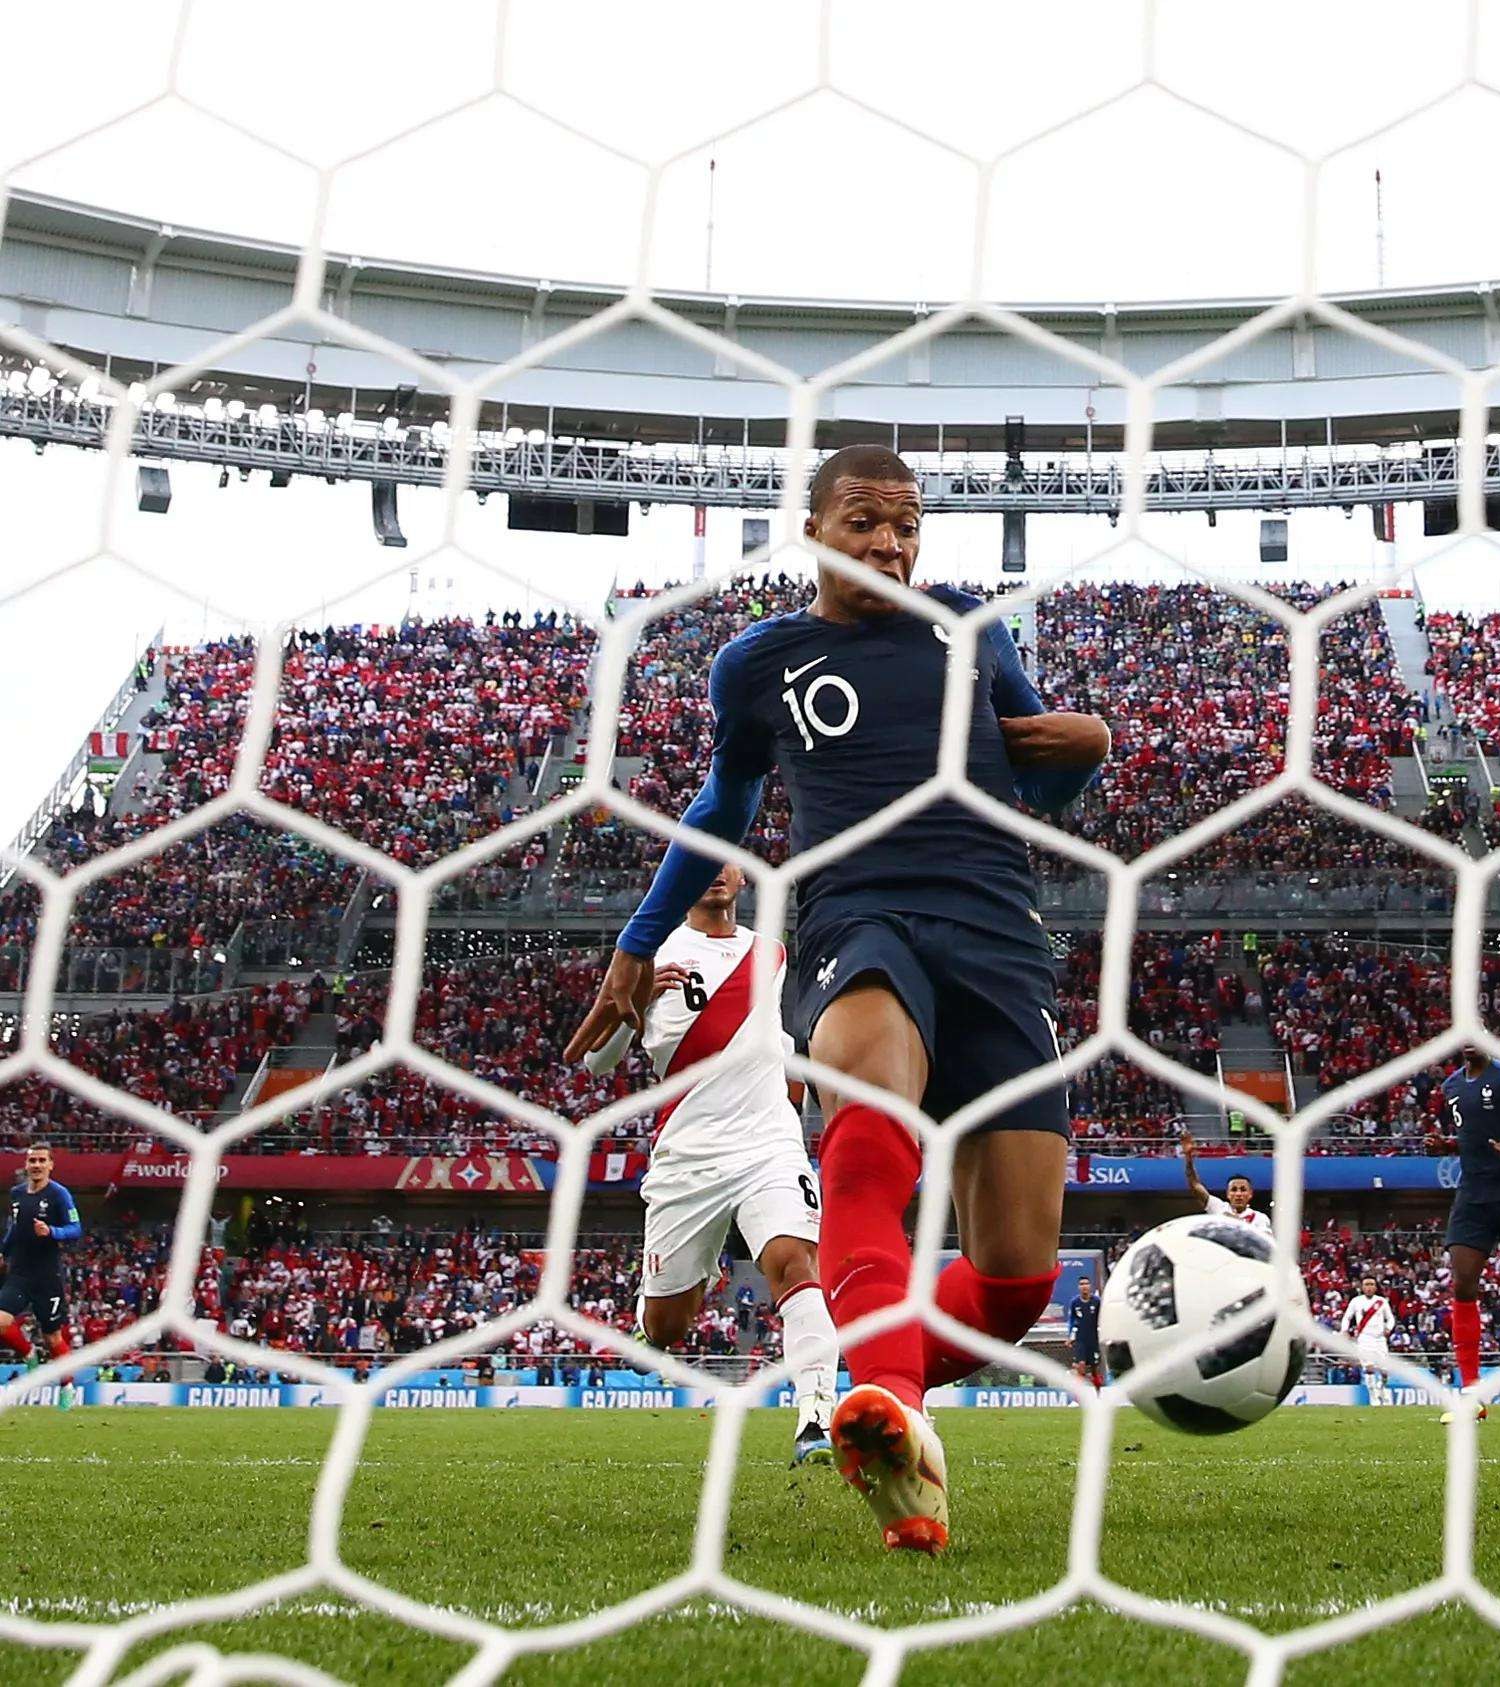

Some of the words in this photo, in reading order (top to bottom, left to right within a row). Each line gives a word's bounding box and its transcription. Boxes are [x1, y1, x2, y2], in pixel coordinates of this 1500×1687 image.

[782, 674, 859, 751] 10
[683, 971, 708, 1012] 6
[122, 1159, 230, 1182] #worldp
[49, 1297, 60, 1315] 7
[188, 1388, 280, 1407] GAZPROM
[384, 1389, 477, 1408] GAZPROM
[582, 1390, 674, 1408] GAZPROM
